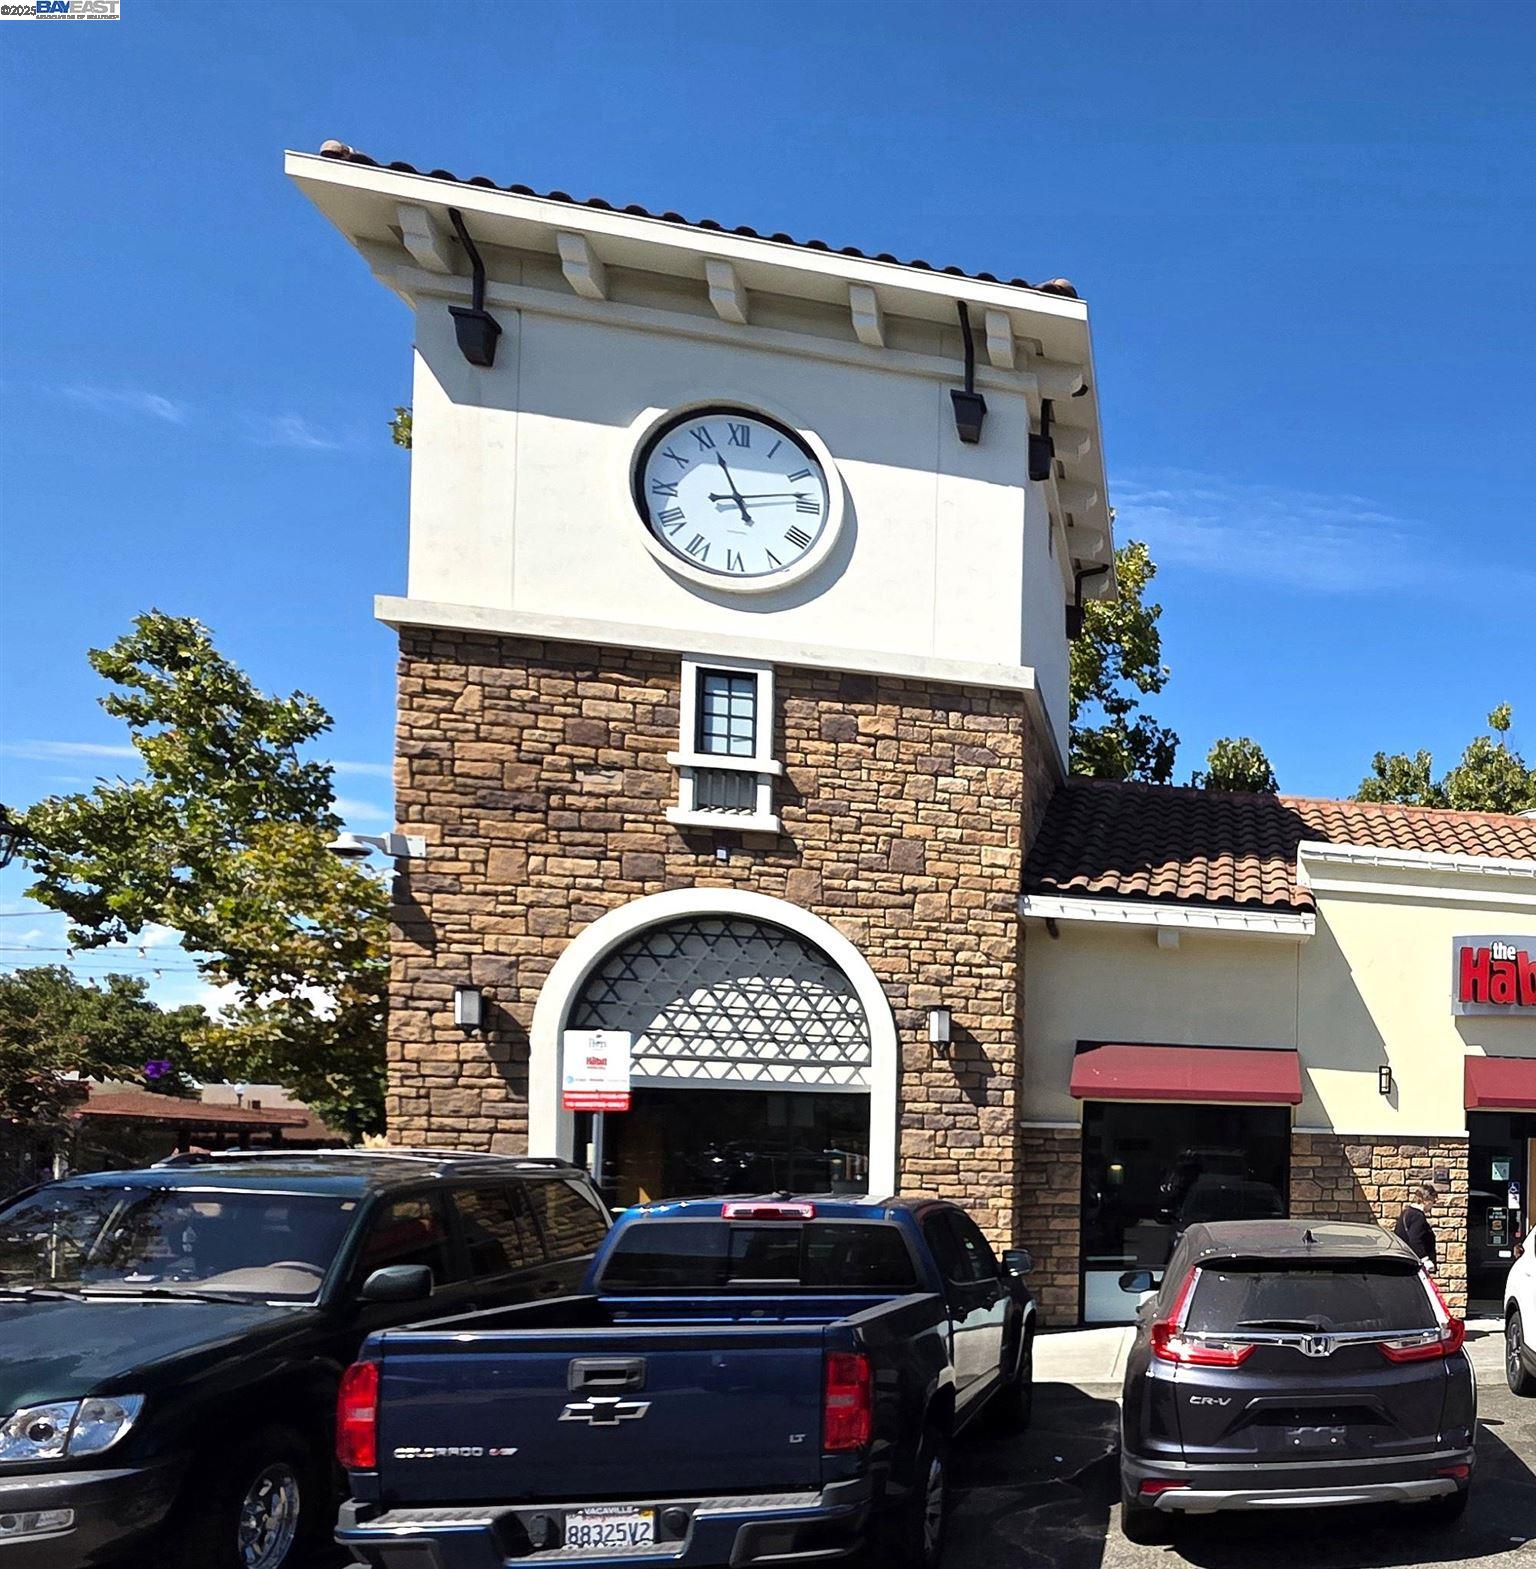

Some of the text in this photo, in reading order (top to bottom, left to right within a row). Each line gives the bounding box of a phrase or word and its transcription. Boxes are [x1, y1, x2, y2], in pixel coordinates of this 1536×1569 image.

[690, 426, 716, 451] XI
[728, 422, 750, 448] XII
[662, 447, 689, 469] X
[652, 478, 678, 497] IX
[658, 507, 687, 536] VIII
[684, 533, 711, 562] VII
[727, 549, 745, 572] VI
[1493, 942, 1516, 960] the
[1190, 1396, 1231, 1405] CR-V
[789, 1434, 805, 1443] LT
[394, 1447, 484, 1459] COLORADO
[584, 1506, 633, 1515] VACAVILLE
[568, 1522, 650, 1545] 88325V2
